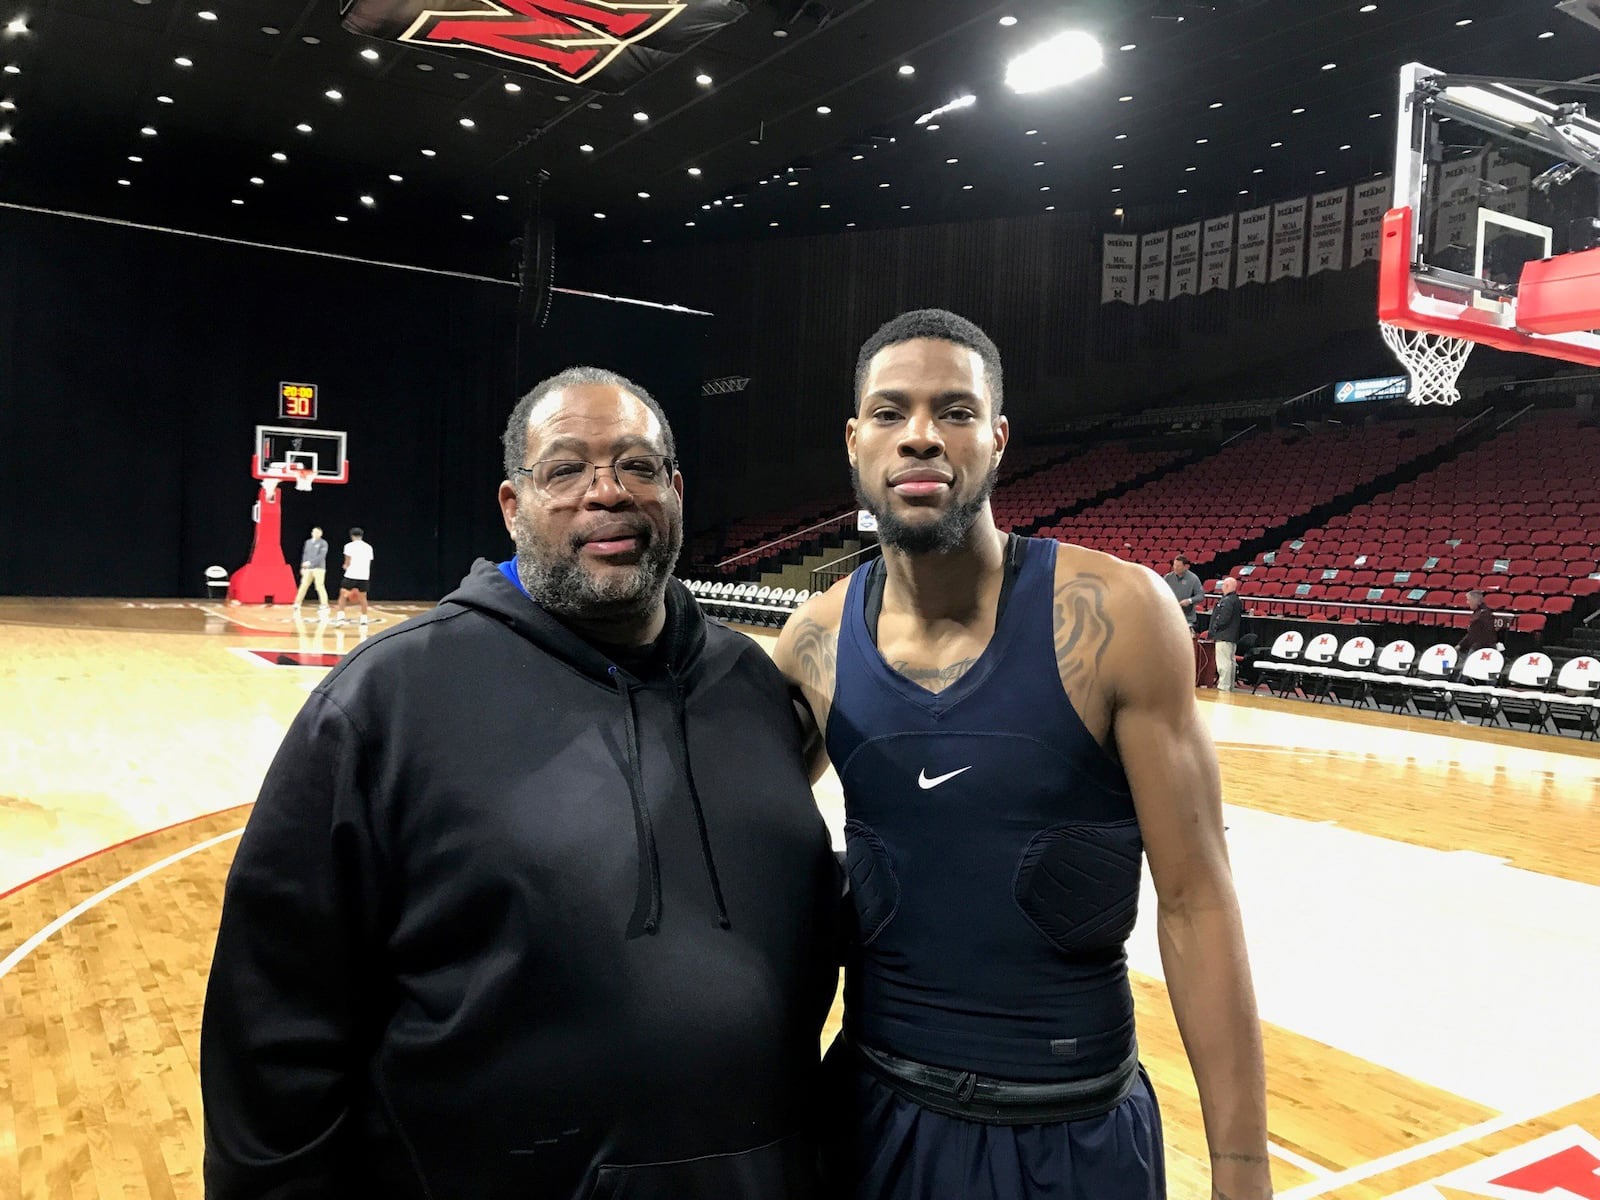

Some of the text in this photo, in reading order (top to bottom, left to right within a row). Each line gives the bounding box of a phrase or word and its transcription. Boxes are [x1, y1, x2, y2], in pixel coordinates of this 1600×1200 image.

[1360, 186, 1386, 198] MIAMI
[1316, 196, 1343, 208] MIAMI
[1278, 204, 1305, 216] MIAMI
[1243, 213, 1266, 224] MIAMI
[1364, 247, 1372, 257] M
[1321, 255, 1329, 265] M
[1113, 289, 1122, 298] M
[283, 386, 313, 398] 20:00
[286, 397, 310, 416] 30
[1286, 634, 1295, 643] M
[1320, 637, 1328, 645] M
[1354, 640, 1363, 649] M
[1395, 644, 1404, 653] M
[1436, 647, 1446, 656] M
[1482, 651, 1492, 661] M
[1528, 656, 1539, 666] M
[1577, 659, 1589, 671] M
